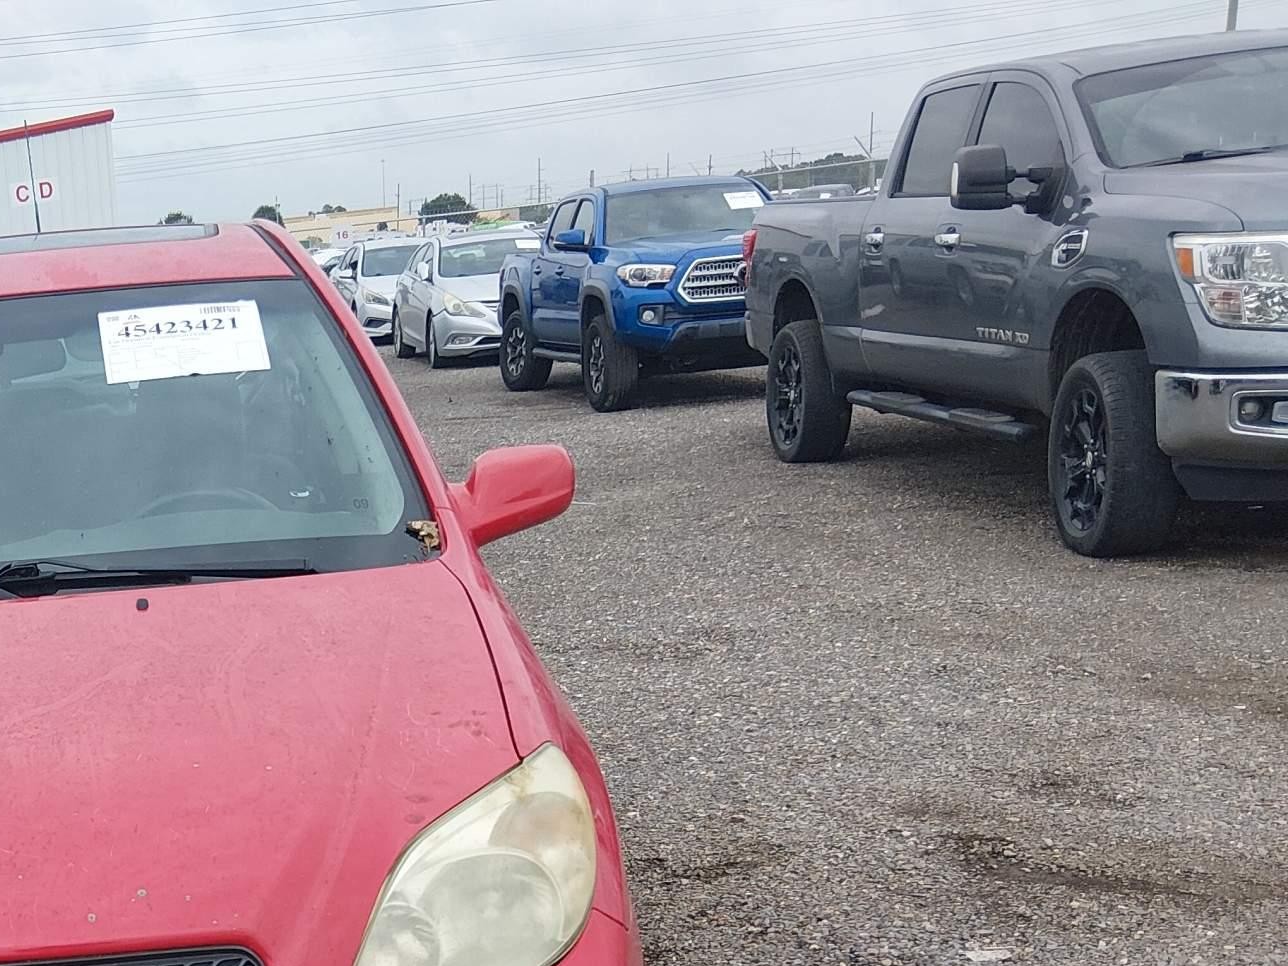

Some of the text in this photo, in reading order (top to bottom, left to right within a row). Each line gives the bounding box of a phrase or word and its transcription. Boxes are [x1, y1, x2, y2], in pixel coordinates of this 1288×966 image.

[15, 181, 53, 203] C D
[335, 231, 349, 240] 16
[117, 316, 239, 339] 45423421
[975, 327, 1013, 341] TITAN
